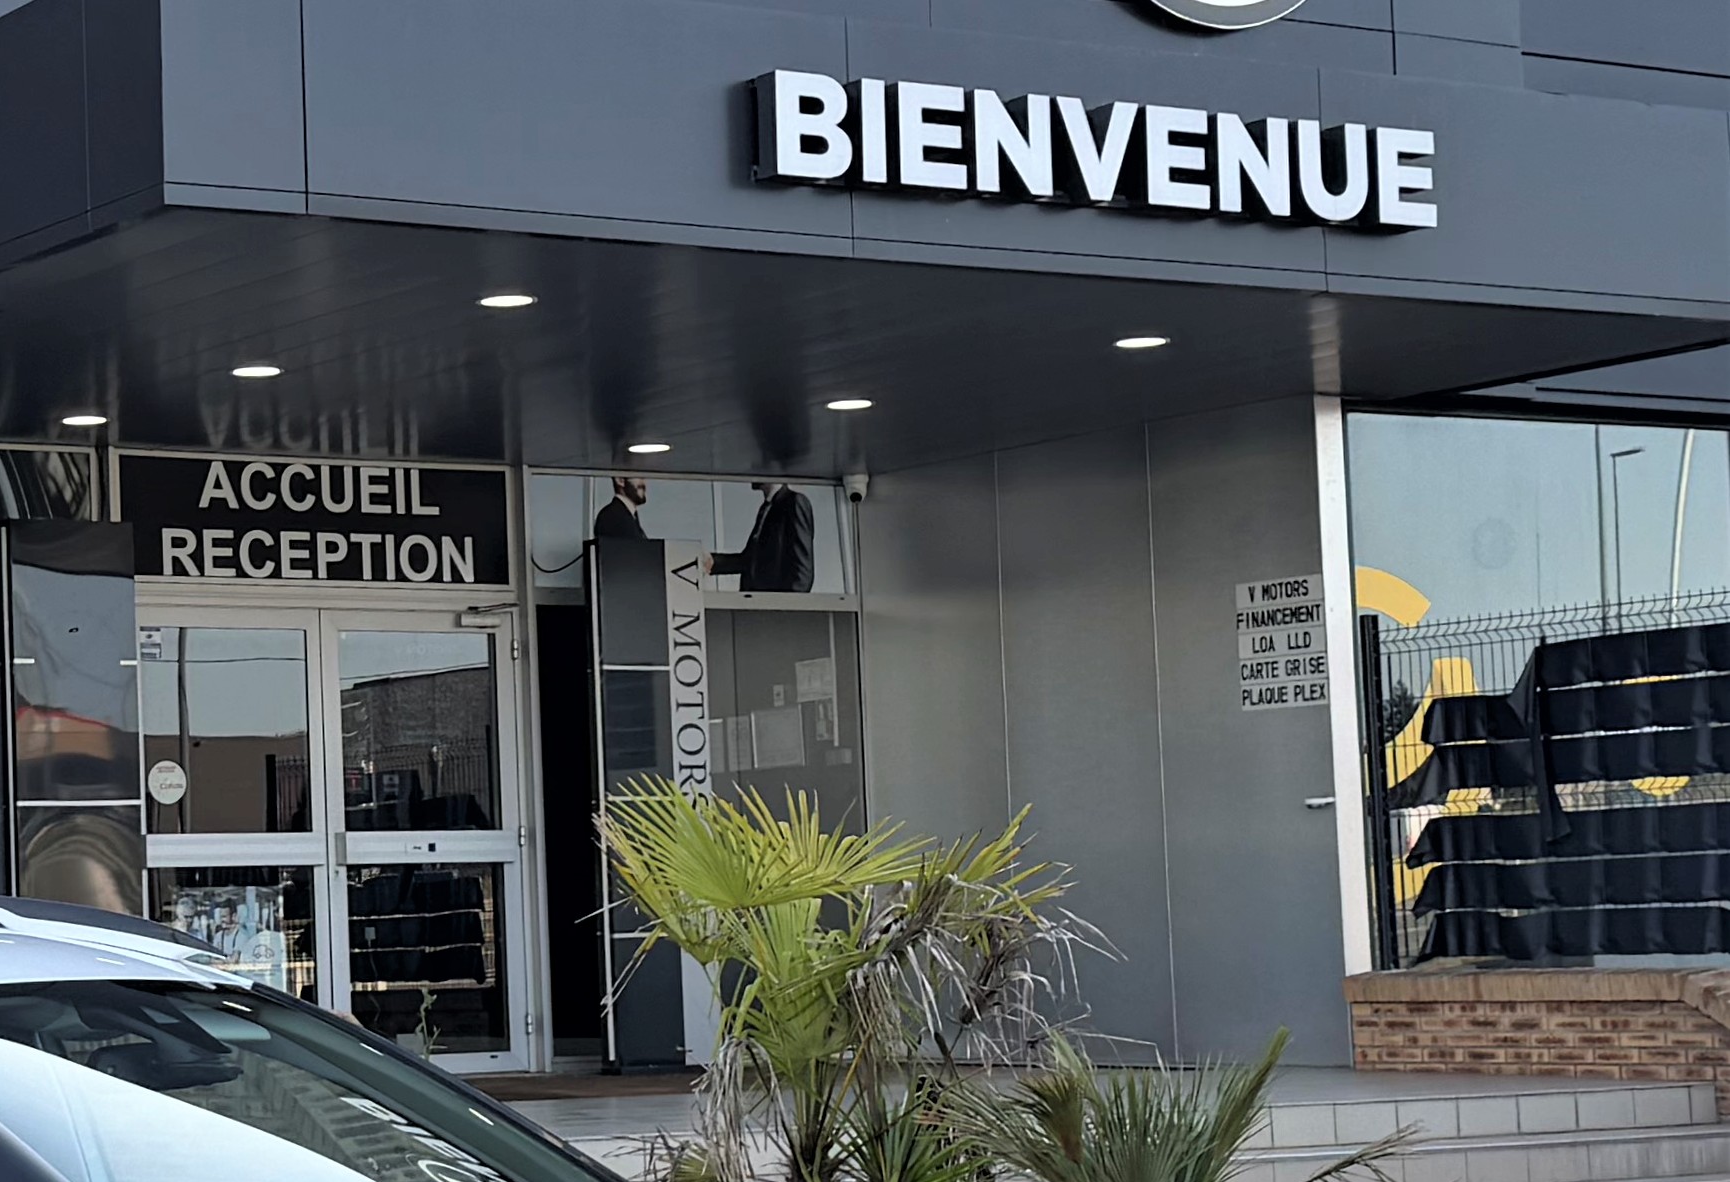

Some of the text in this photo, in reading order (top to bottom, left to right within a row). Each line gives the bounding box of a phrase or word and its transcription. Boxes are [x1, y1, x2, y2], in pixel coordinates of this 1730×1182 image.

[770, 68, 1438, 229] BIENVENUE
[198, 460, 441, 516] ACCUEIL
[161, 527, 475, 583] RECEPTION
[670, 556, 700, 591] V
[1248, 579, 1309, 603] V MOTORS
[1236, 603, 1321, 630] FINANCEMENT
[1251, 631, 1312, 654] LOA LLD
[1240, 655, 1326, 681] CARTE GRISE
[1242, 682, 1327, 707] PLAQUE PLEX
